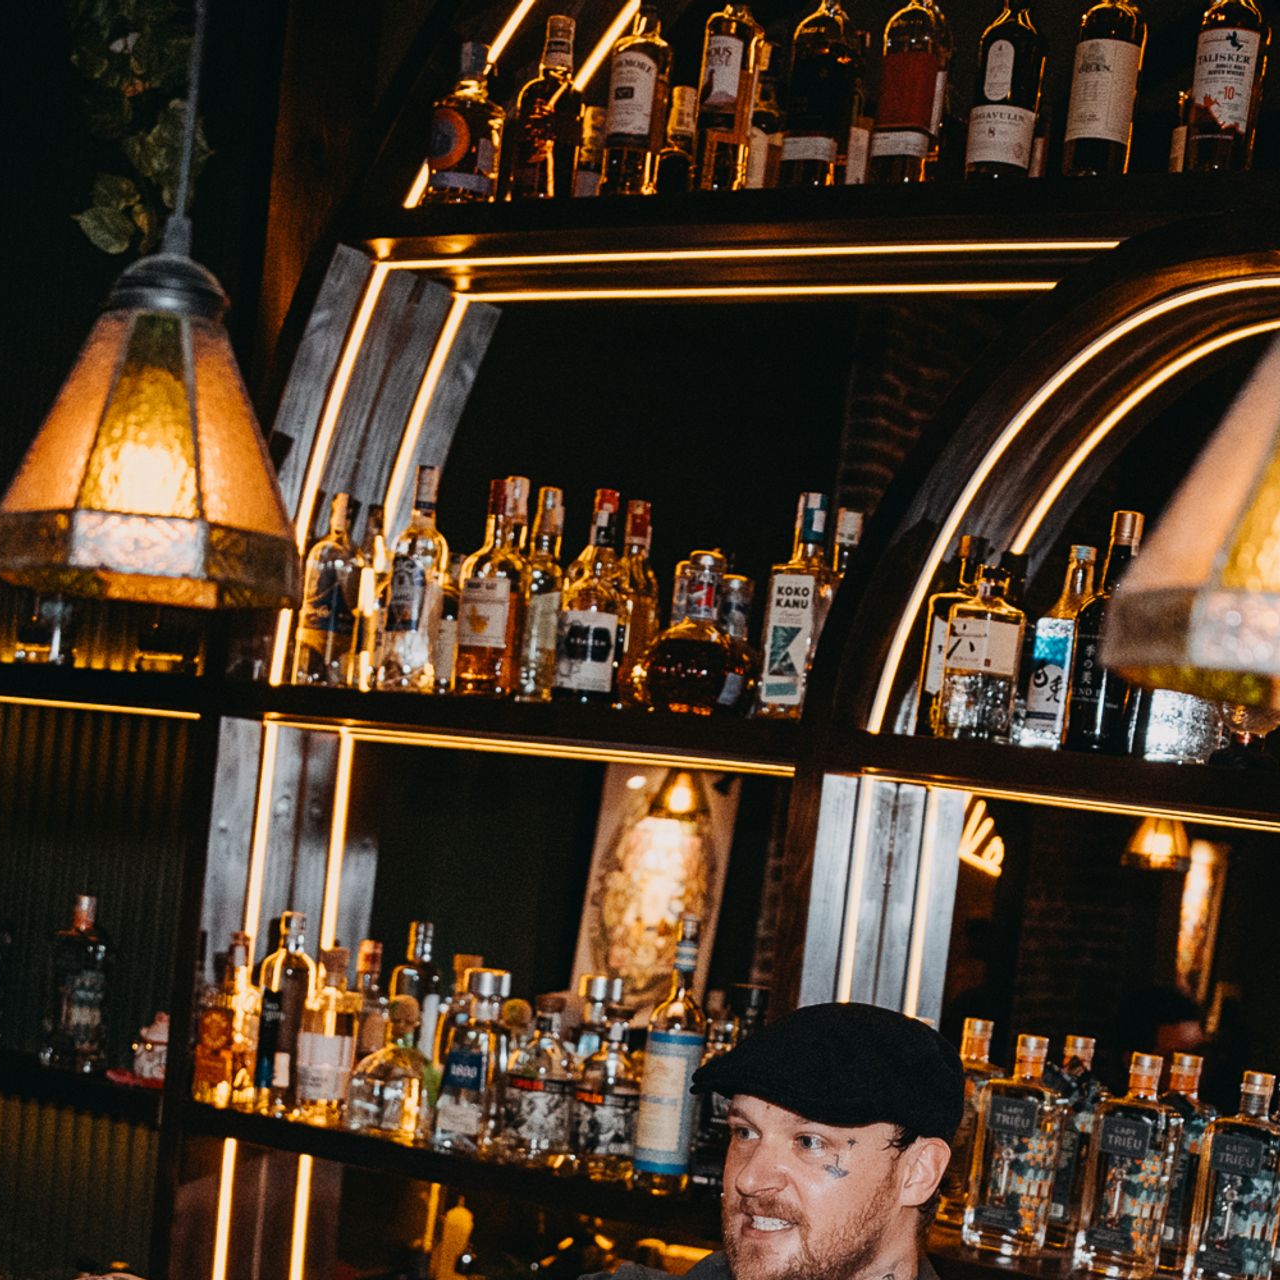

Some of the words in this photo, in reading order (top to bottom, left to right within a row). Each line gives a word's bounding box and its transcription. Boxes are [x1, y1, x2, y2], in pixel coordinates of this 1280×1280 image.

[1198, 53, 1251, 65] TALISKER
[1223, 86, 1235, 100] 10
[987, 126, 995, 138] 8
[777, 585, 810, 598] KOKO
[775, 598, 809, 610] KANU
